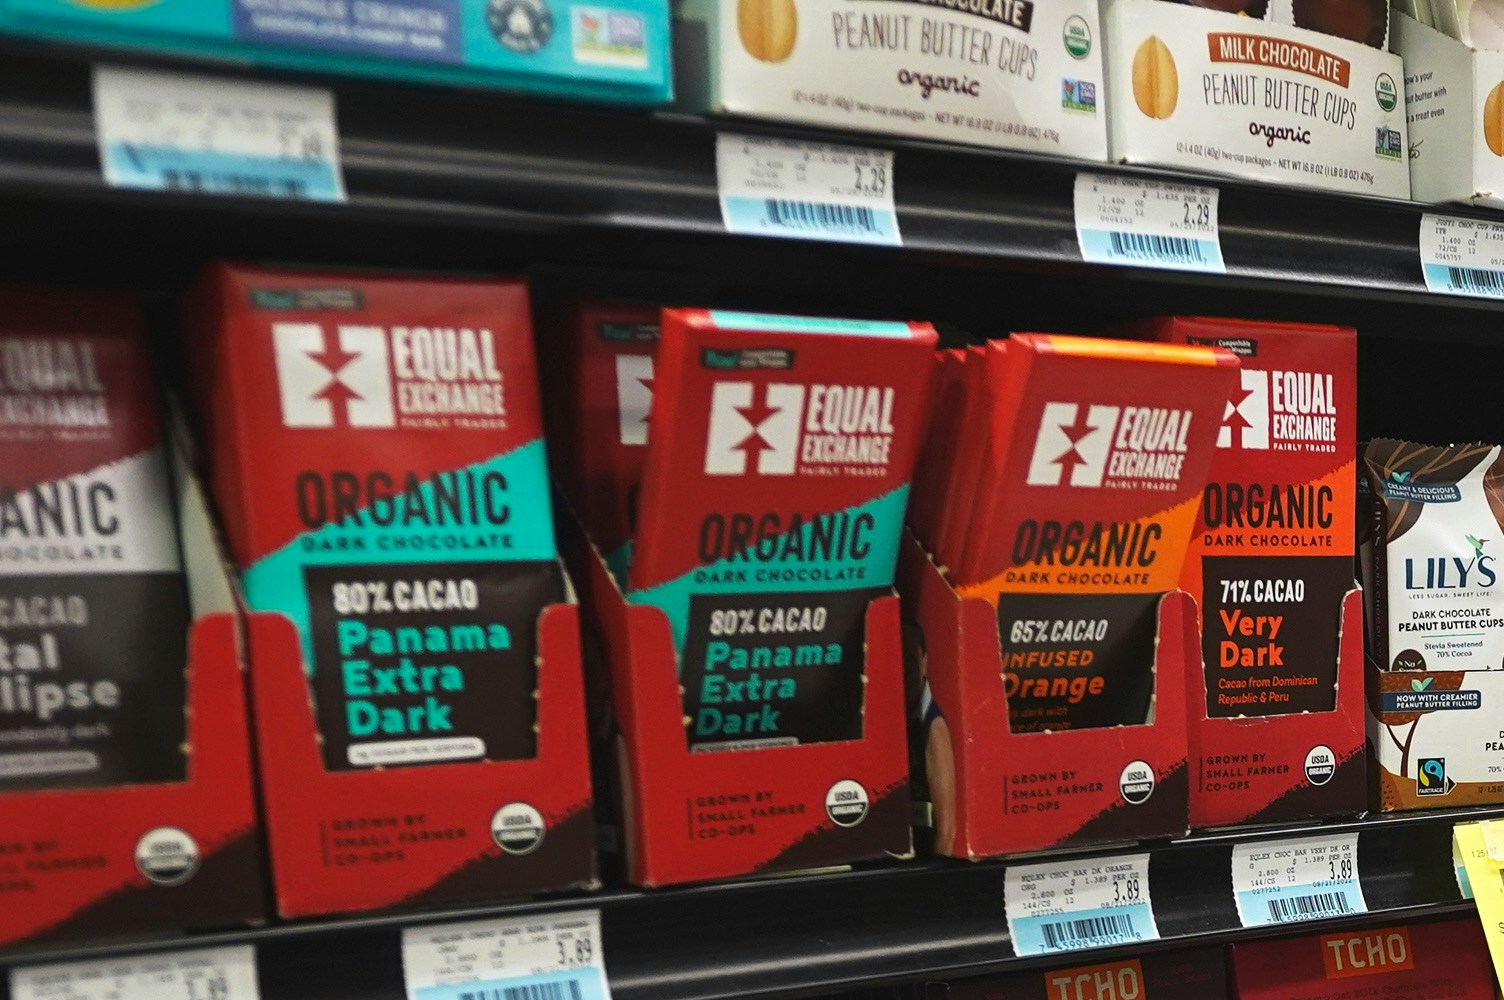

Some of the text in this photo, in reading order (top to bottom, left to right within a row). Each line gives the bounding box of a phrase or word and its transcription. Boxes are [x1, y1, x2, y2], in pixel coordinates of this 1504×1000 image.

[832, 11, 912, 51] PEANUT
[921, 19, 991, 66] BUTTER
[999, 36, 1038, 82] CUPS
[1219, 36, 1341, 81] MILK CHOCOLATE
[897, 68, 981, 99] organic
[1203, 73, 1358, 131] PEANUT BUTTER CUPS
[1249, 122, 1311, 147] organic
[391, 327, 502, 380] EQUAL
[1273, 370, 1336, 413] EQUAL
[1273, 413, 1336, 441] EXCHANGE
[296, 471, 510, 529] ORGANIC
[1203, 483, 1333, 529] ORGANIC
[1204, 534, 1332, 547] DARK CHOCOLATE
[333, 581, 479, 613] 80% CACAO
[1220, 579, 1304, 604] 71% CACAO
[337, 621, 510, 657] Panama
[1011, 620, 1109, 643] 65% CACAO
[1219, 609, 1283, 640] Very
[1220, 643, 1283, 667] Dark
[340, 661, 464, 696] Extra
[1218, 673, 1318, 690] Cacao from Dominican
[1218, 691, 1257, 705] Republic
[1270, 691, 1290, 703] Peru
[346, 701, 453, 736] Dark
[1312, 755, 1329, 766] USDA
[1488, 765, 1502, 774] 70%
[1113, 879, 1139, 901] 3.89
[1327, 933, 1408, 971] TCHO
